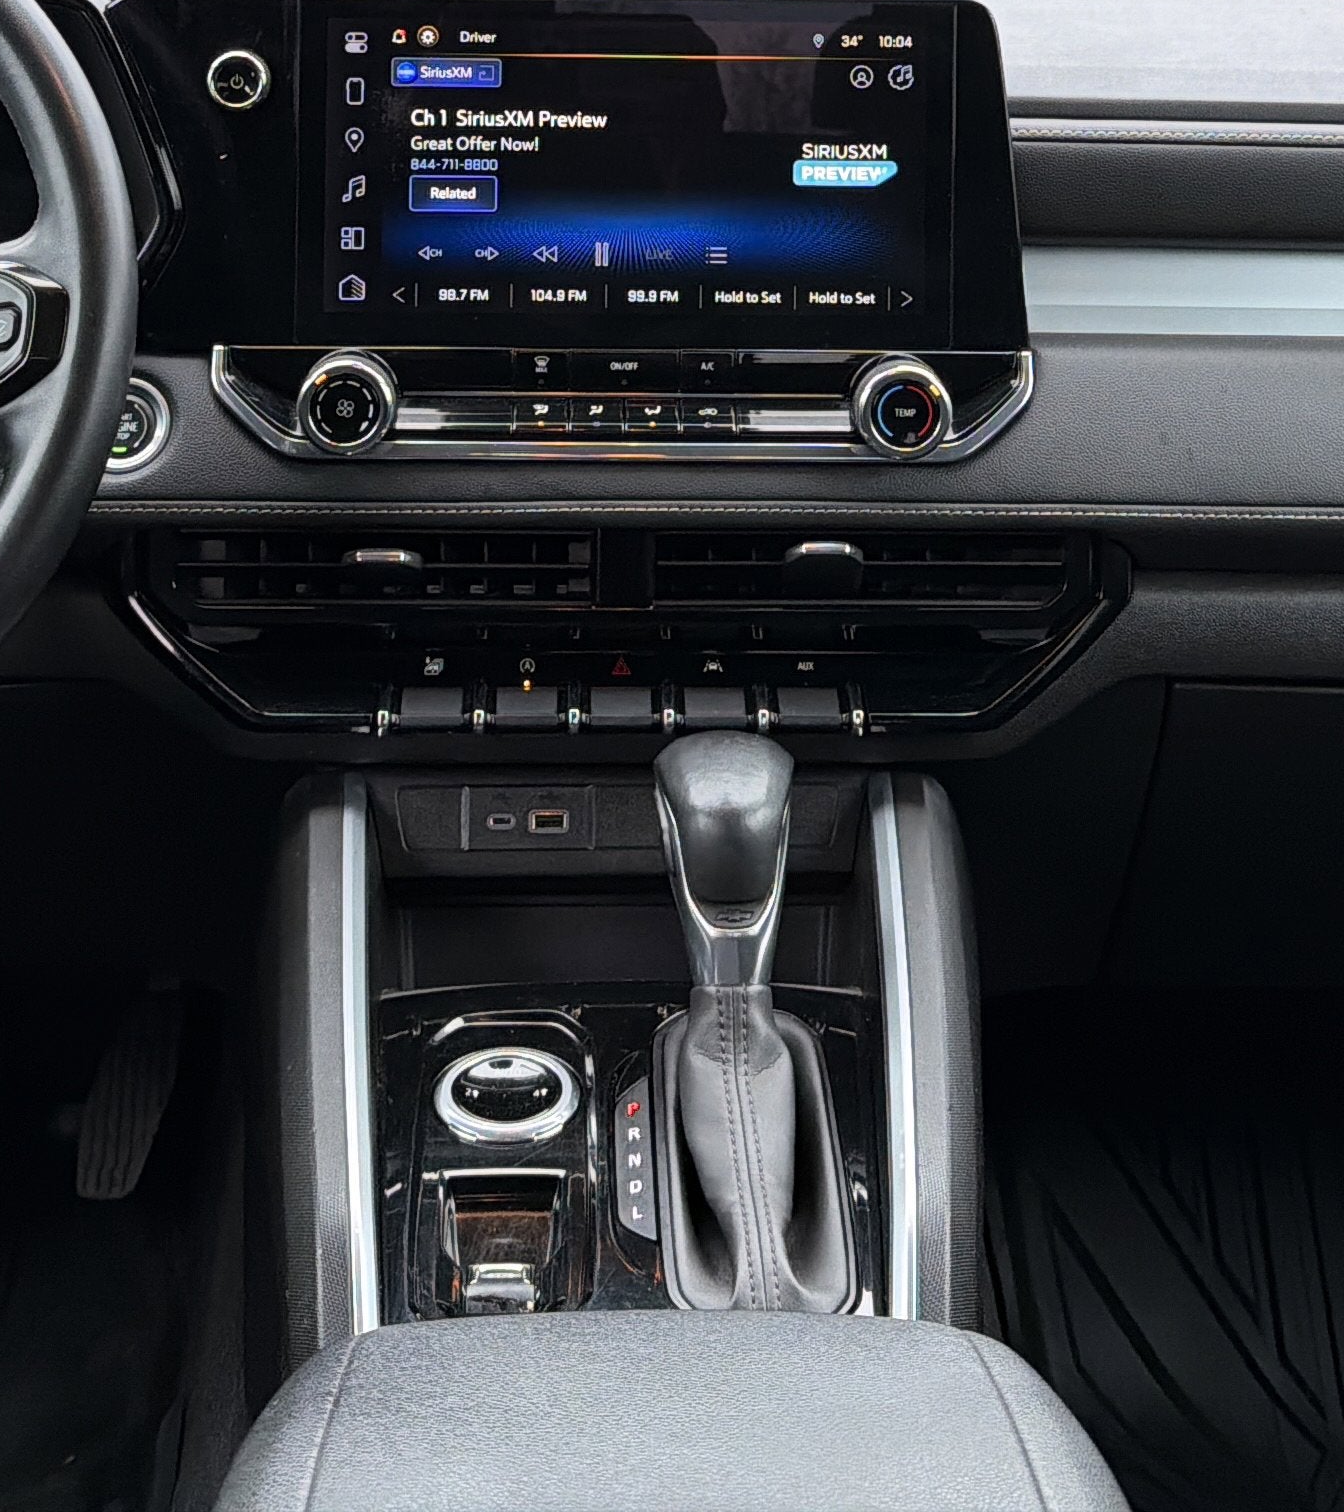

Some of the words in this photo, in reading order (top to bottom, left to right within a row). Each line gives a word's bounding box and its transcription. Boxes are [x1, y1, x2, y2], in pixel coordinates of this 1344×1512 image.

[459, 30, 497, 43] Driver
[840, 34, 864, 48] 34°
[878, 35, 913, 48] 10:04
[420, 65, 473, 79] SiriusXM
[410, 108, 435, 127] Ch
[439, 109, 448, 127] 1
[455, 109, 534, 128] SiriusXM
[538, 110, 608, 128] Preview
[410, 136, 453, 151] Great
[455, 136, 497, 151] Offer
[500, 137, 540, 152] Now!
[802, 143, 888, 159] SIRIUSXM
[410, 158, 499, 171] 844-711-8800
[801, 165, 888, 181] PREVIEW
[430, 187, 477, 200] Related
[438, 288, 467, 301] 98.7
[469, 288, 489, 301] FM
[530, 288, 565, 302] 104.9
[567, 289, 587, 302] FM
[627, 290, 657, 303] 99.9
[659, 290, 679, 303] FM
[714, 290, 744, 304] Hold
[745, 291, 759, 304] to
[761, 290, 782, 304] Set
[808, 291, 838, 305] Hold
[839, 292, 853, 305] to
[855, 291, 876, 305] Set
[610, 361, 638, 371] ON/OFF
[701, 361, 714, 371] A/C
[895, 407, 917, 418] TEMP
[797, 661, 815, 671] AUX
[626, 1101, 641, 1118] P
[627, 1127, 641, 1143] R
[628, 1152, 642, 1168] N
[629, 1179, 643, 1195] D
[632, 1206, 643, 1220] L
